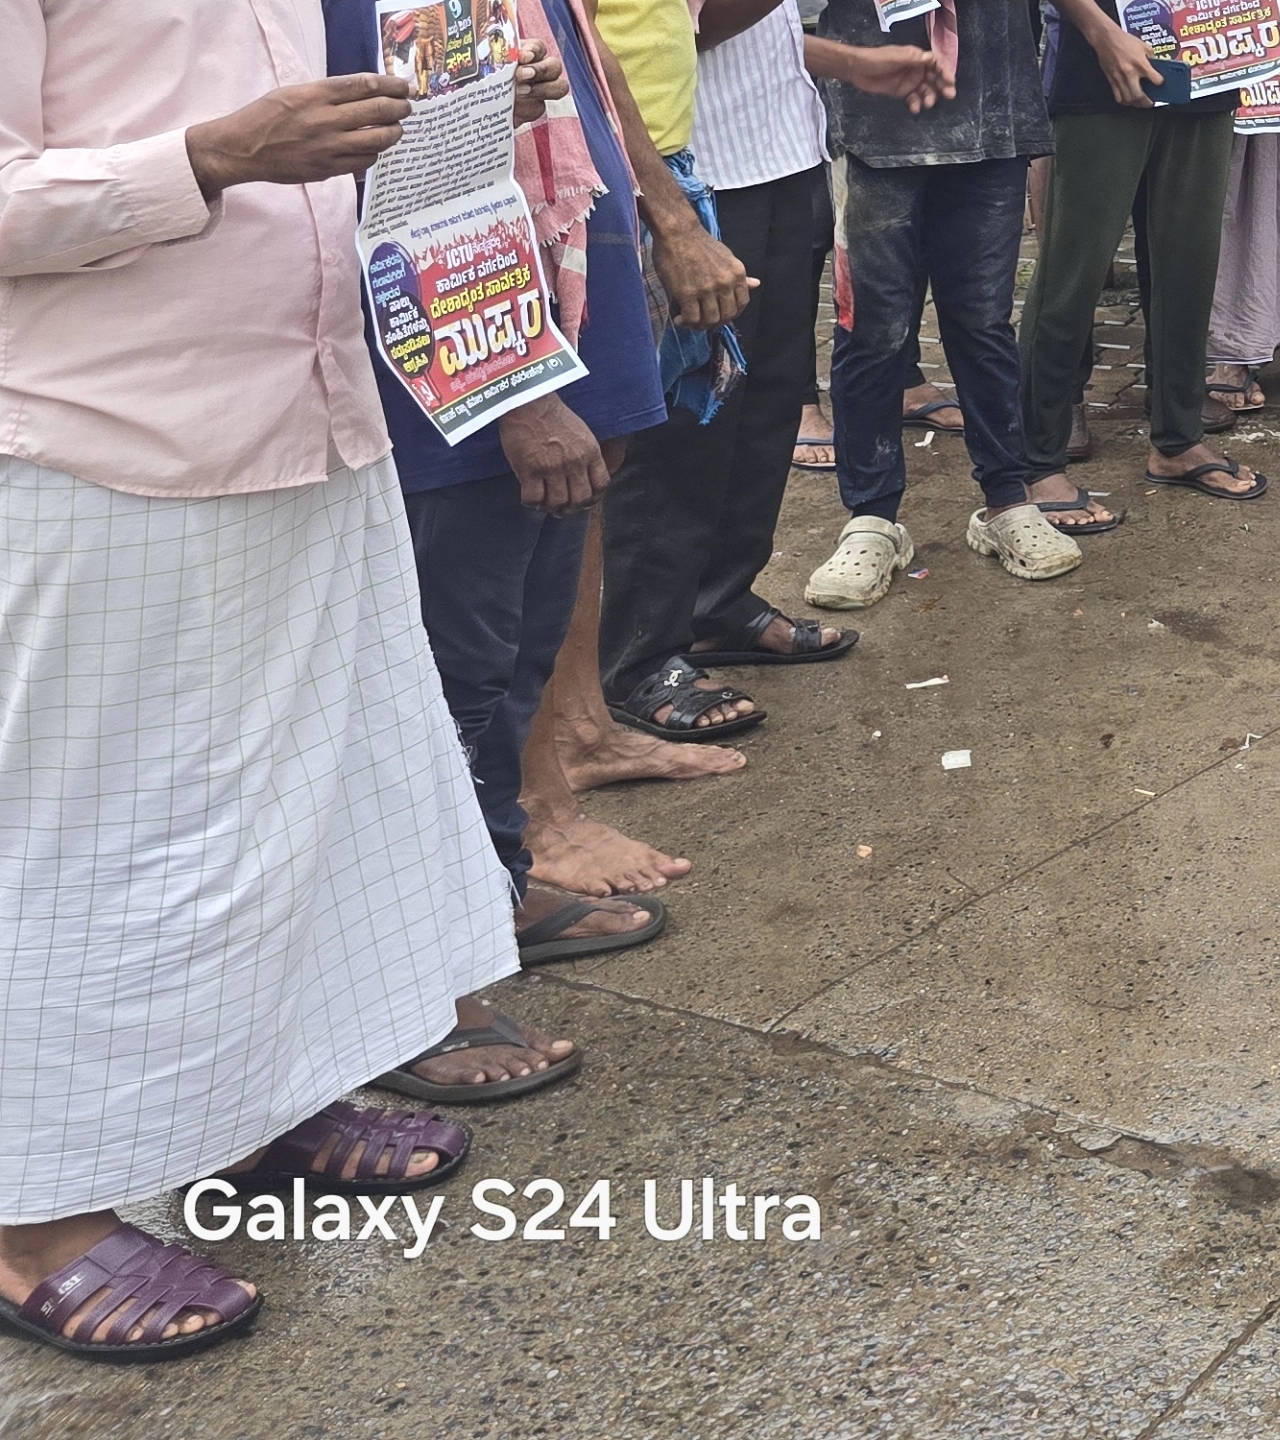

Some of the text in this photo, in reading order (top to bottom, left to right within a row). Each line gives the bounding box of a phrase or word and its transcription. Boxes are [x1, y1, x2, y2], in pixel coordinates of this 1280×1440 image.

[1179, 19, 1280, 67] ಮುಷ್ಕರ
[446, 243, 474, 269] JCTU
[434, 289, 542, 376] ಮುಷ್ಕರ
